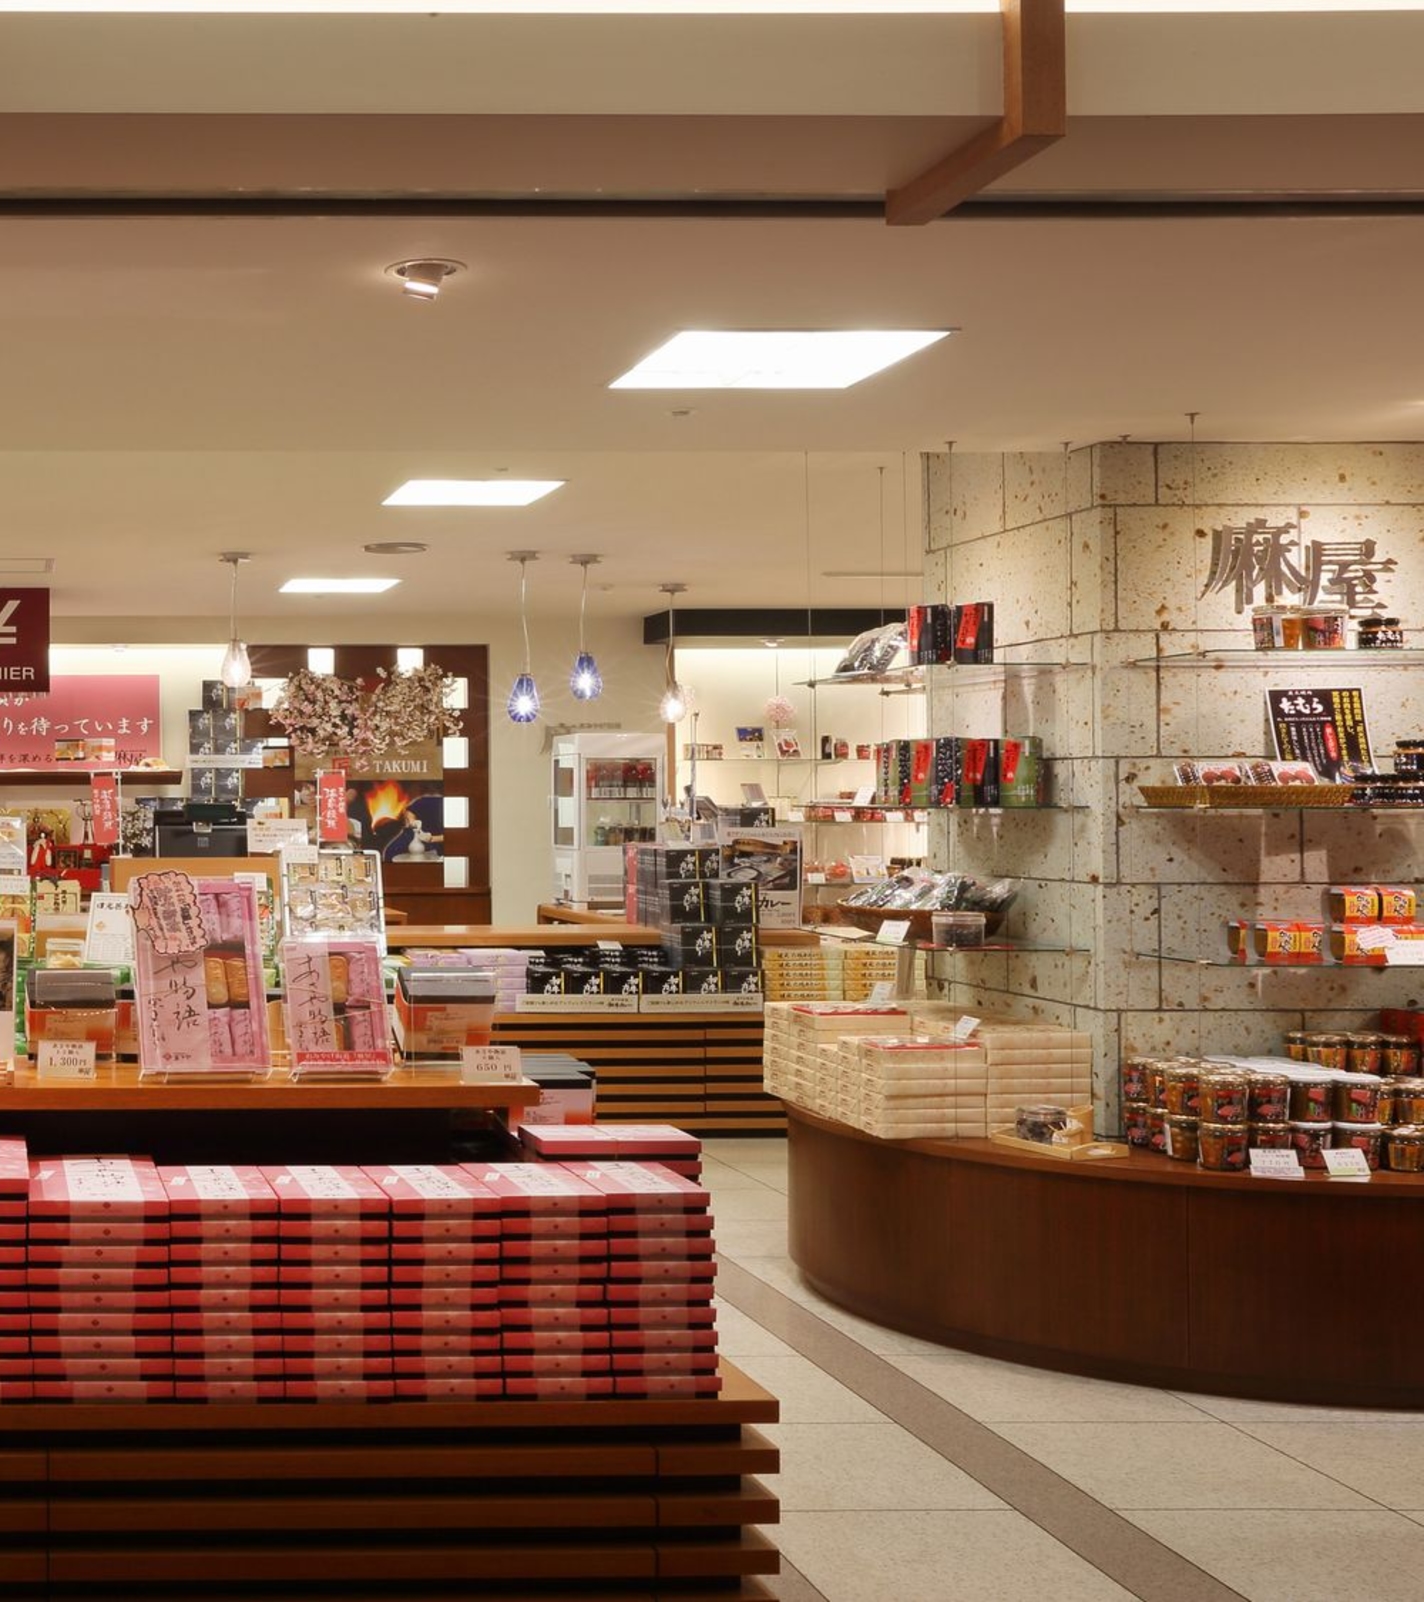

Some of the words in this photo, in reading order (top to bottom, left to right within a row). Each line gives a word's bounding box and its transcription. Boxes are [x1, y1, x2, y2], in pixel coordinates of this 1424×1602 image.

[1201, 518, 1398, 620] 麻屋
[1279, 696, 1324, 714] たむら
[373, 759, 428, 773] TAKUMI
[759, 896, 791, 908] カレー
[49, 1056, 87, 1067] 1,300円
[476, 1063, 498, 1072] 650
